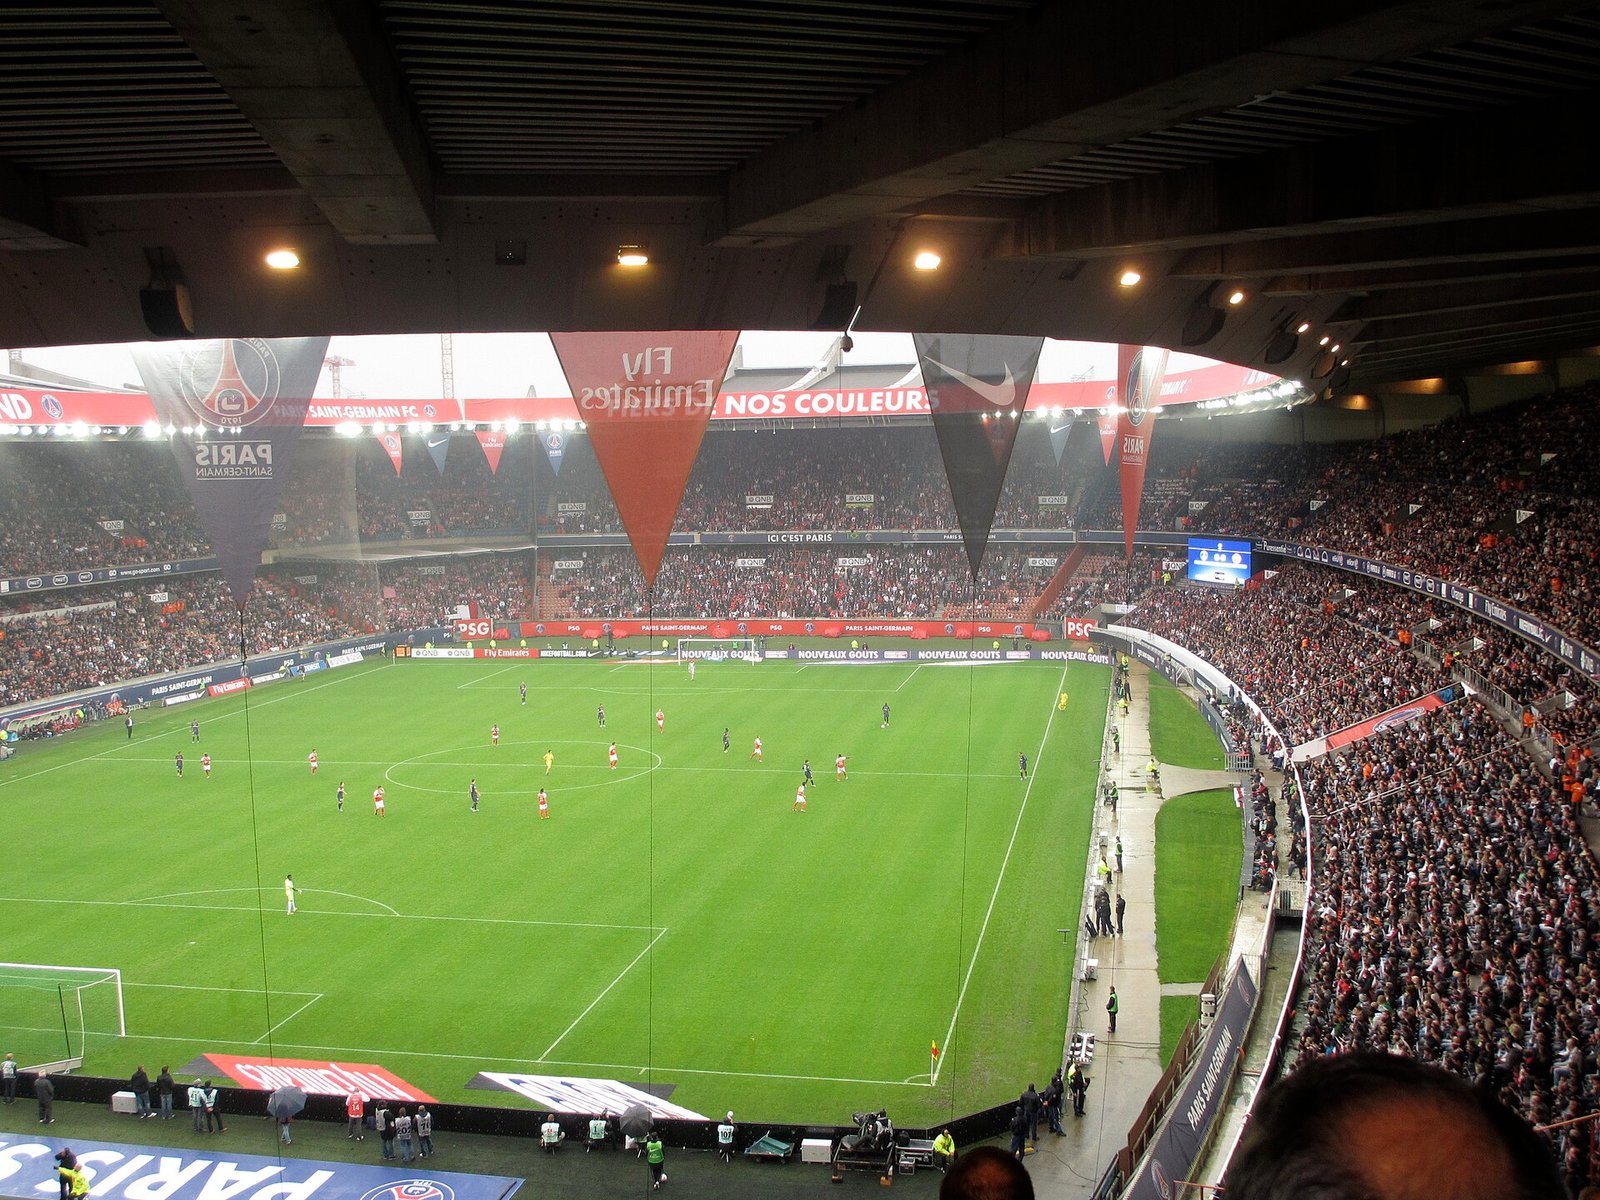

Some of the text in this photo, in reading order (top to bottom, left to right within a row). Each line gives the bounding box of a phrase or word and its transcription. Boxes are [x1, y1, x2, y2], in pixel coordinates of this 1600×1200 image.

[725, 394, 786, 415] NOS
[794, 391, 939, 414] COULEURS
[309, 405, 401, 418] SAINT-GERMAIN
[402, 405, 418, 417] FC
[106, 522, 122, 530] QNB
[767, 534, 832, 542] ICI C'EST PARIS
[152, 593, 166, 601] QNB
[459, 622, 490, 636] PSG
[484, 648, 530, 658] Fly Emirates
[730, 650, 760, 658] GOUTS
[799, 650, 846, 659] NOUVEAUX
[848, 650, 879, 659] GOUTS
[918, 651, 968, 659] NOUVEAUX
[969, 651, 1001, 660] GOUTS
[1041, 651, 1087, 661] NOUVEAUX
[1087, 653, 1109, 664] GOUTS
[151, 684, 169, 696] PARIS
[212, 678, 247, 695] Fly Emirates
[1186, 1089, 1206, 1132] PARIS
[35, 1150, 336, 1200] PARIS
